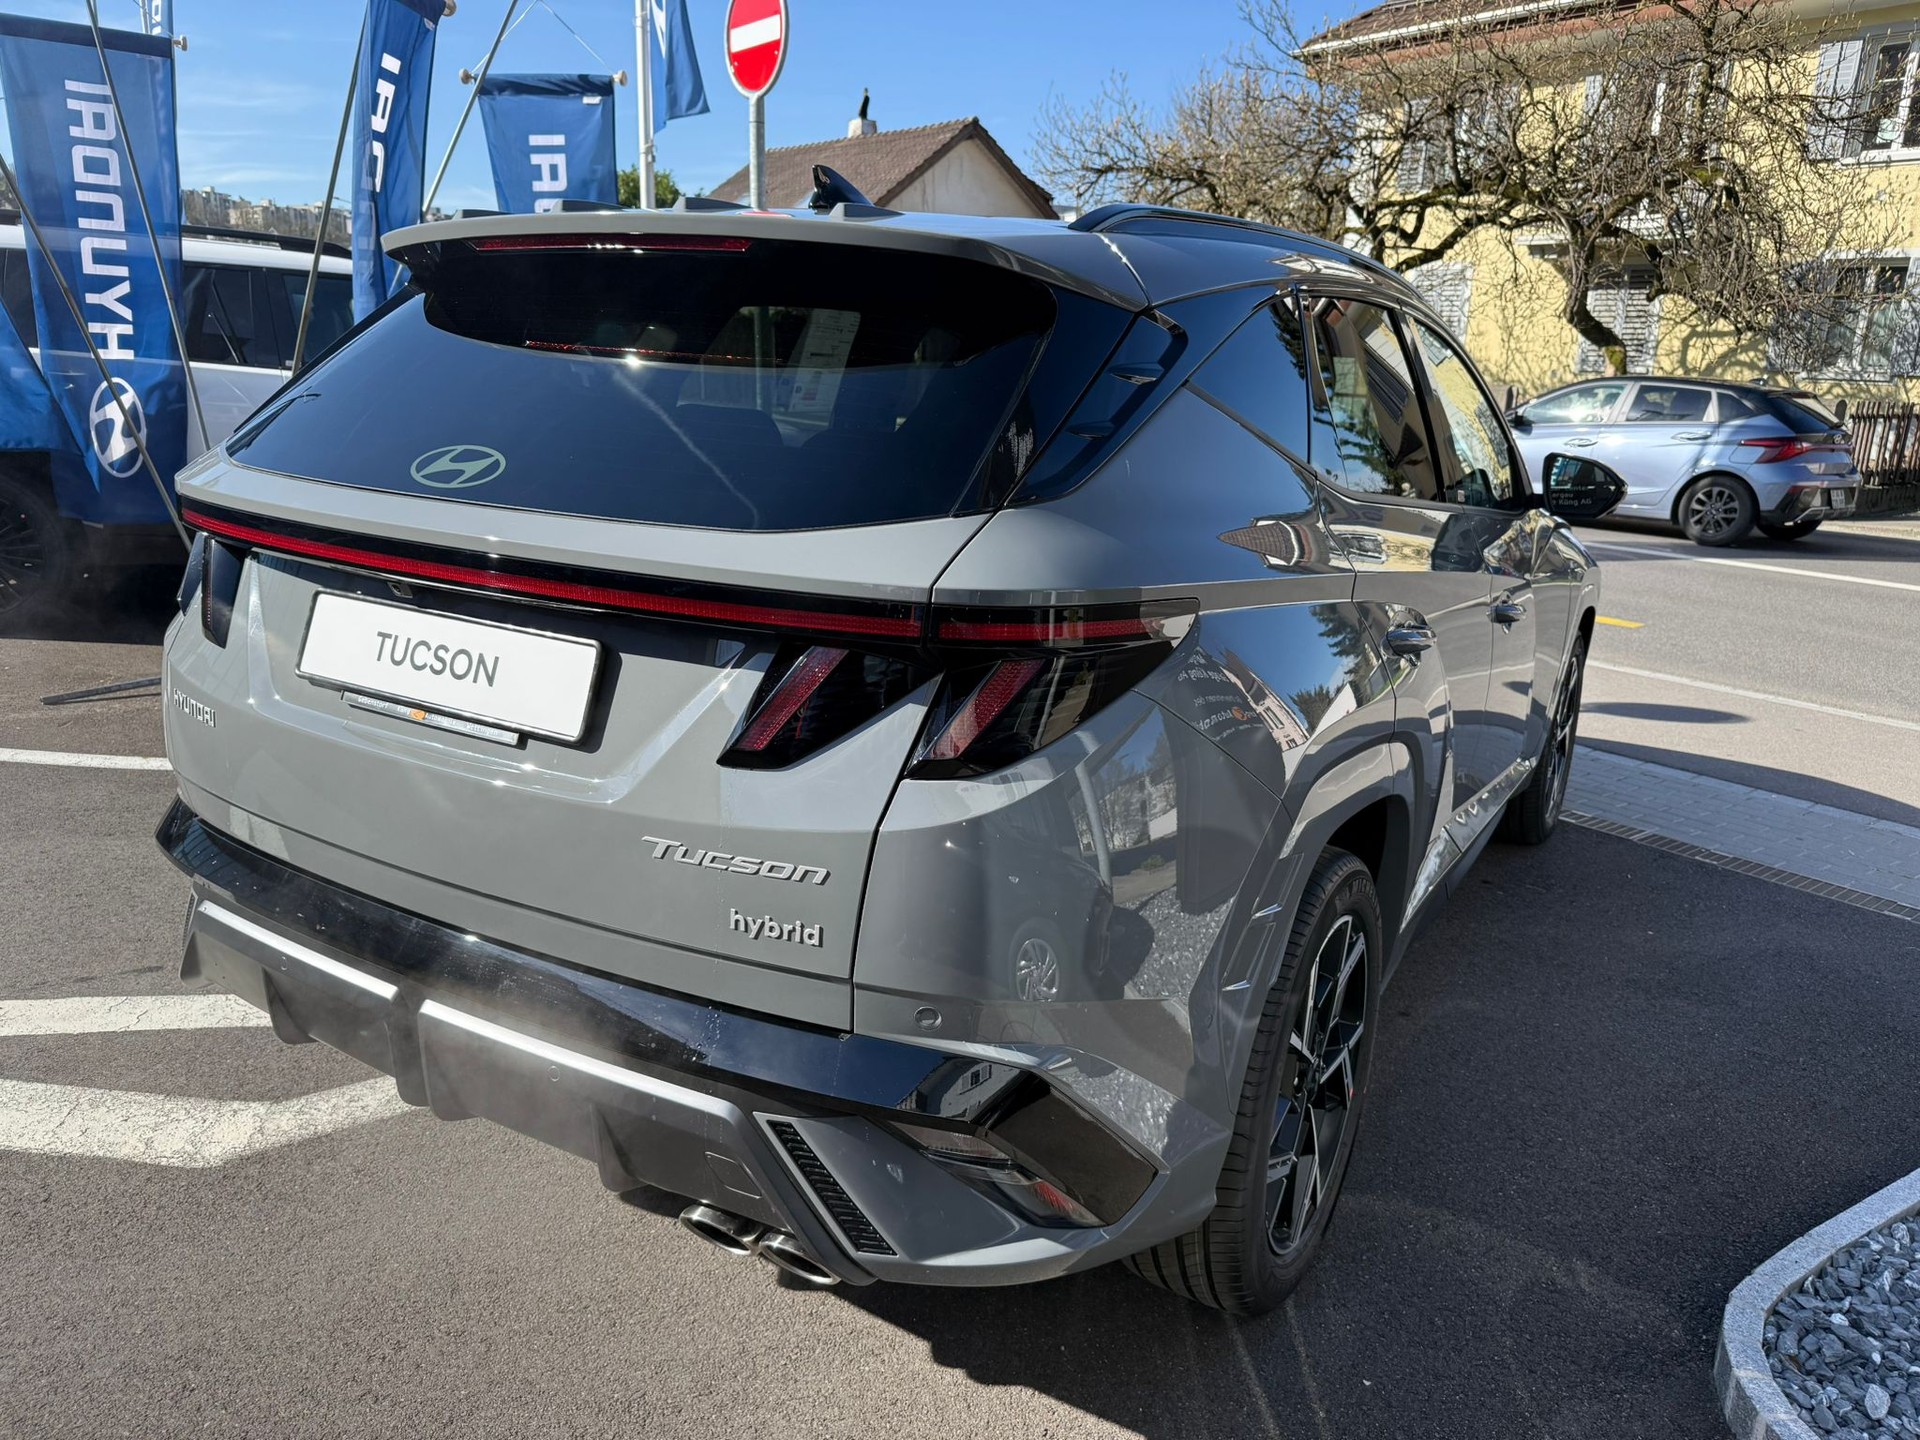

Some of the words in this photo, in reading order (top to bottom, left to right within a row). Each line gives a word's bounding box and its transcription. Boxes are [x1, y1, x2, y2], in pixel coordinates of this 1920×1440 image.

[376, 631, 499, 687] TUCSON
[173, 687, 216, 728] HYUNDAI
[729, 908, 823, 947] hybrid
